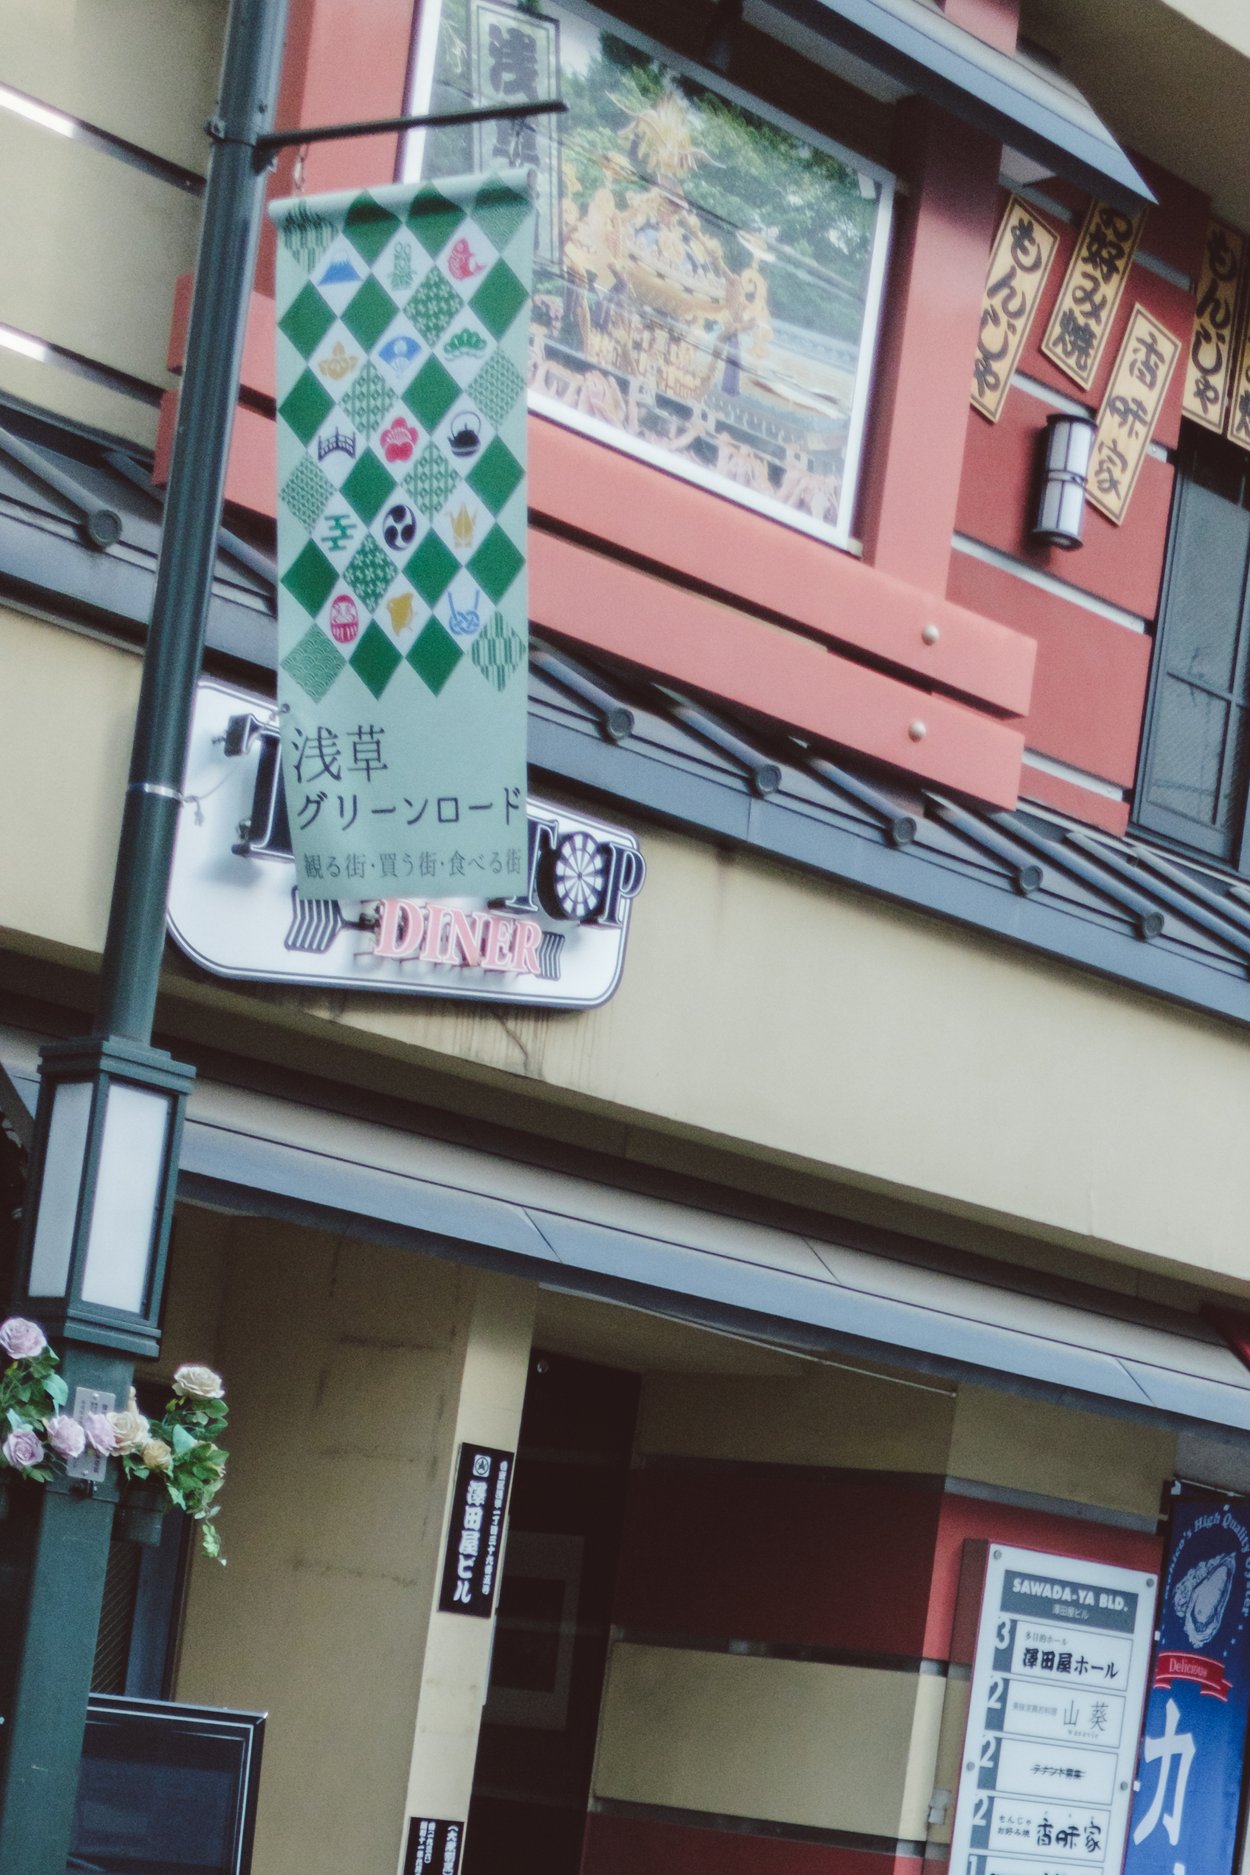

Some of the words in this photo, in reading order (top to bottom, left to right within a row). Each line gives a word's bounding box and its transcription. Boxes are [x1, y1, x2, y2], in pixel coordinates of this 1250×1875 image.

[292, 724, 388, 783] 浅草
[297, 786, 522, 832] グリーンロード
[374, 898, 542, 976] DINER
[1194, 1511, 1221, 1533] High
[1221, 1512, 1250, 1553] Quality
[1012, 1577, 1095, 1606] SAWADA-YA
[1098, 1592, 1129, 1611] BLD.
[1022, 1647, 1119, 1680] 澤田屋ホール
